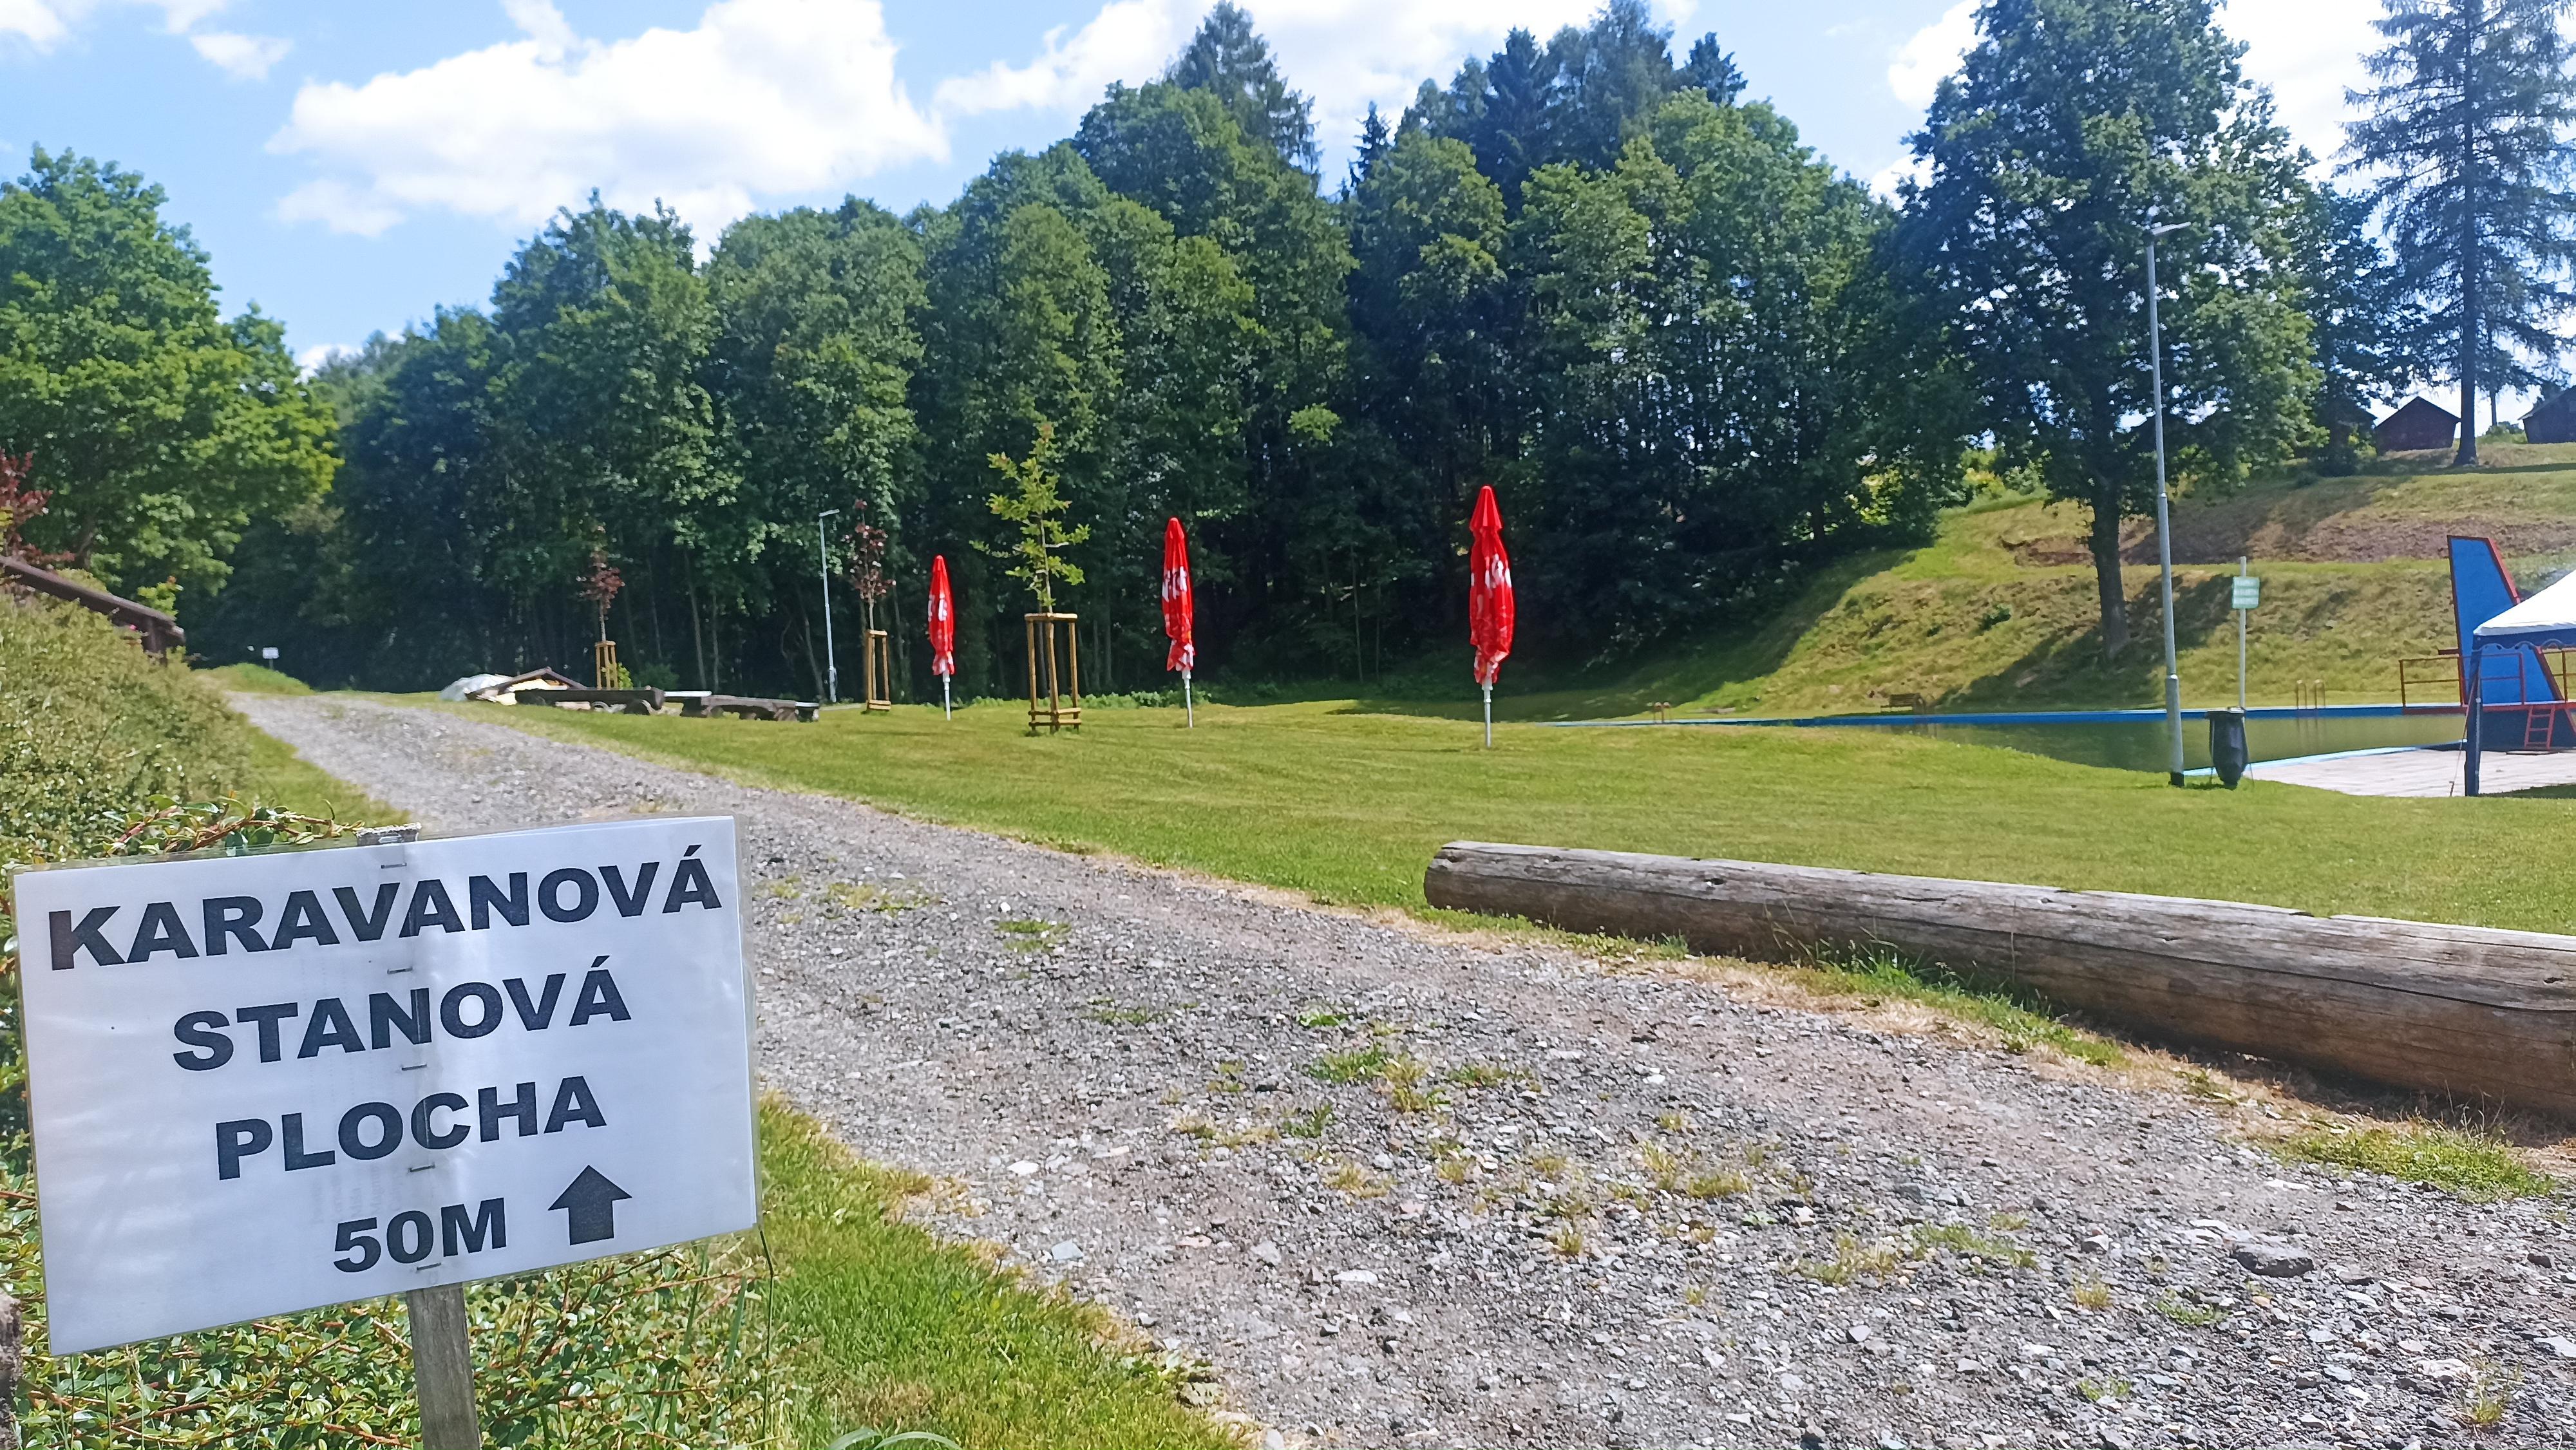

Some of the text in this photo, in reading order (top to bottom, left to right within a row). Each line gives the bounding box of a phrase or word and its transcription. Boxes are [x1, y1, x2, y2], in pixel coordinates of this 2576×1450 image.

[49, 845, 722, 970] KARAVANOVÁ
[173, 956, 631, 1071] STANOVÁ
[216, 1076, 607, 1180] PLOCHA
[334, 1198, 506, 1272] 50M
